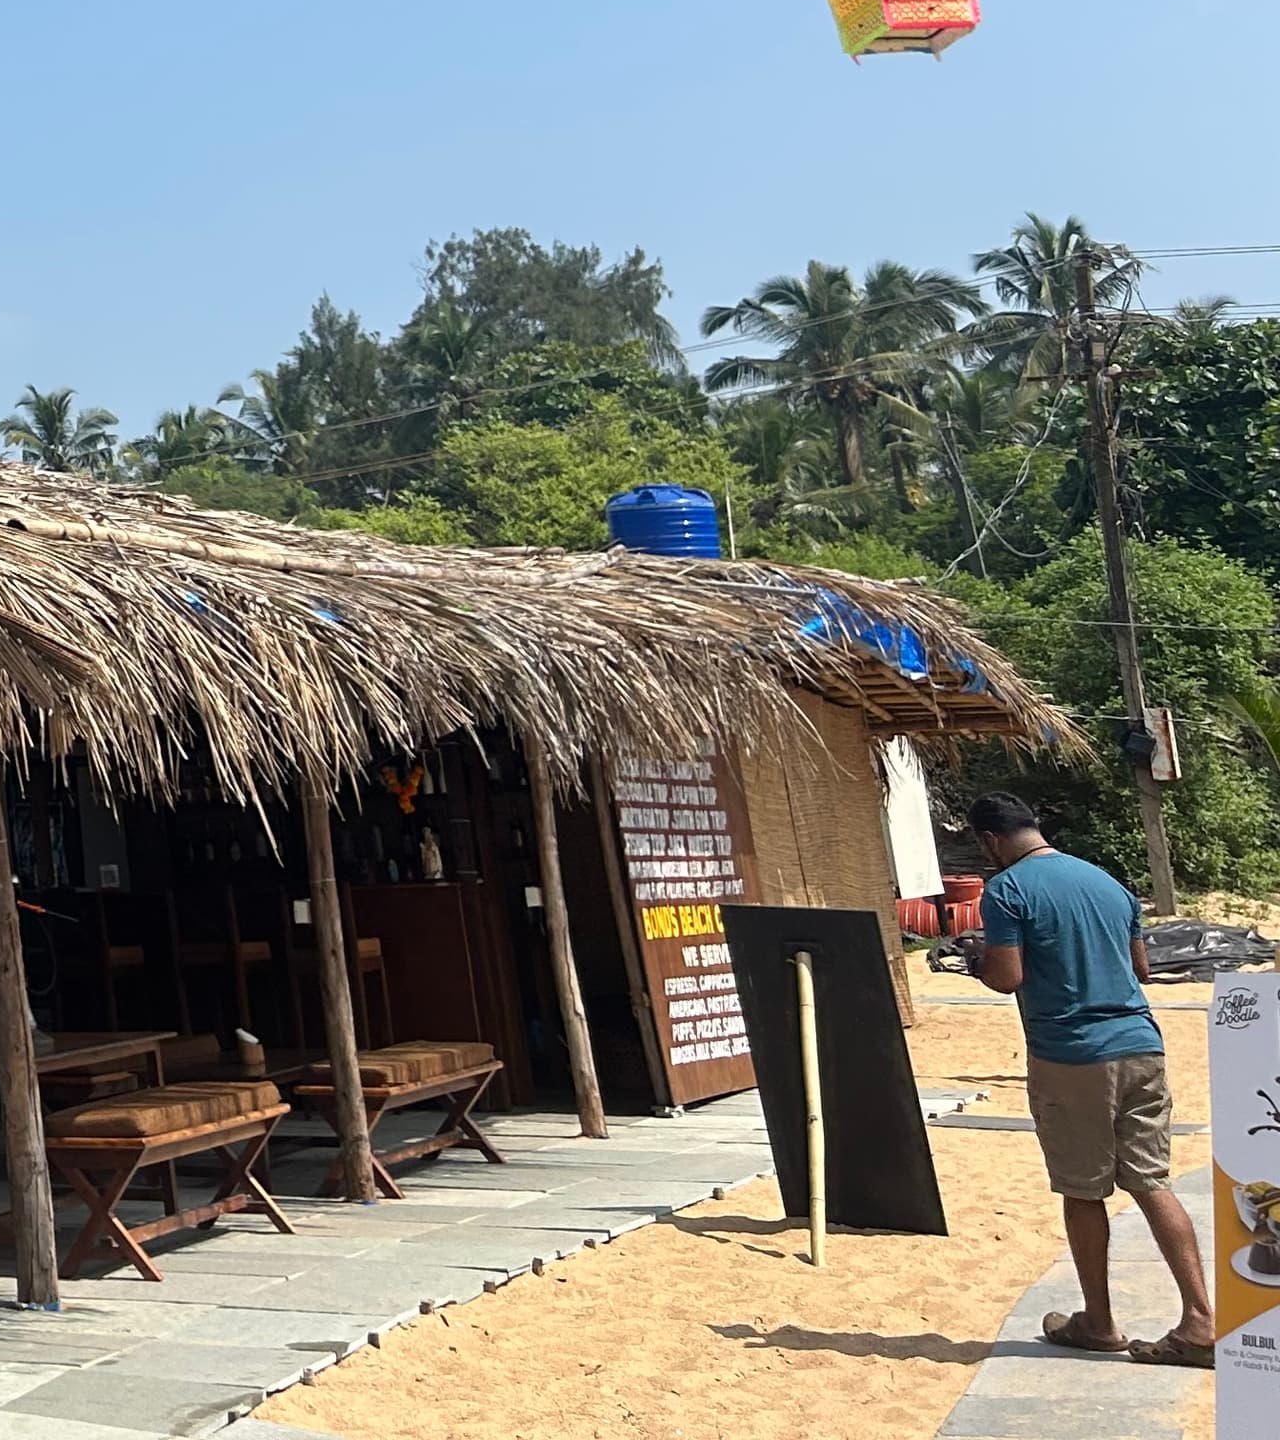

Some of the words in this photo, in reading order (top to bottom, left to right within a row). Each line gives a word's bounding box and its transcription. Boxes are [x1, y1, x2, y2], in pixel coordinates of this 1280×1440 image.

[678, 904, 715, 936] BEACH
[682, 945, 699, 968] WE
[1217, 994, 1258, 1014] Toffee
[1215, 1007, 1260, 1025] Doodle
[1241, 1334, 1276, 1350] BULBUL
